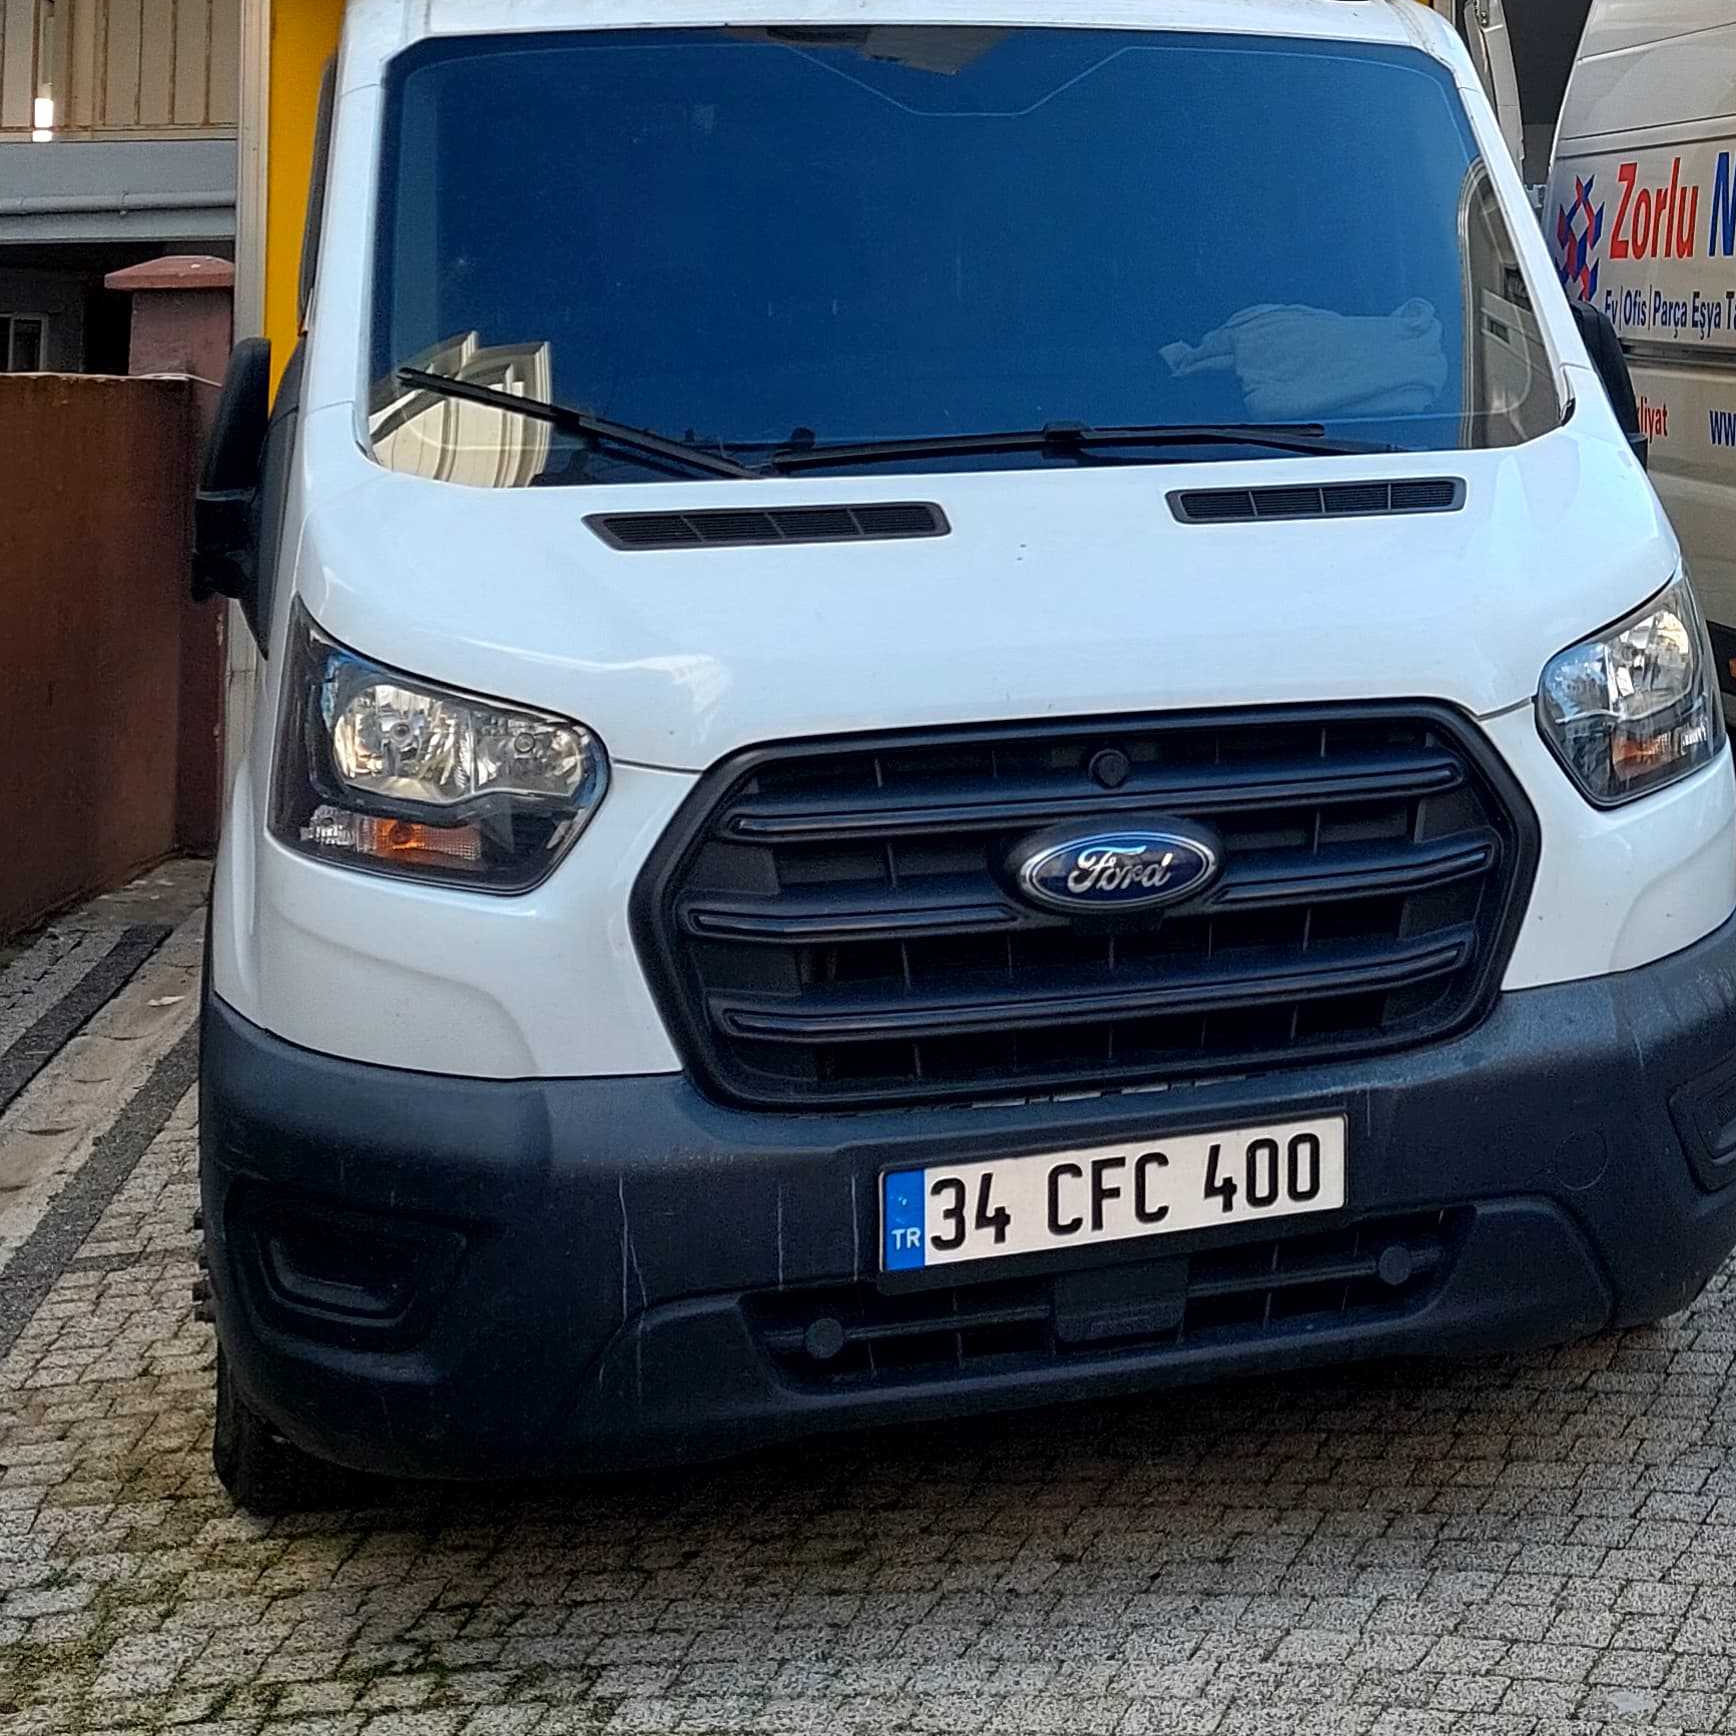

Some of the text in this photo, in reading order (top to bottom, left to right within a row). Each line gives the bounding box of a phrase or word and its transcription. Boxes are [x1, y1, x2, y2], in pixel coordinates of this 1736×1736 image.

[1609, 157, 1699, 260] Zorlu
[1691, 291, 1721, 341] Eşya
[1066, 845, 1174, 893] Ford
[930, 1133, 1321, 1252] 34 CFC 400
[891, 1227, 921, 1250] TR
